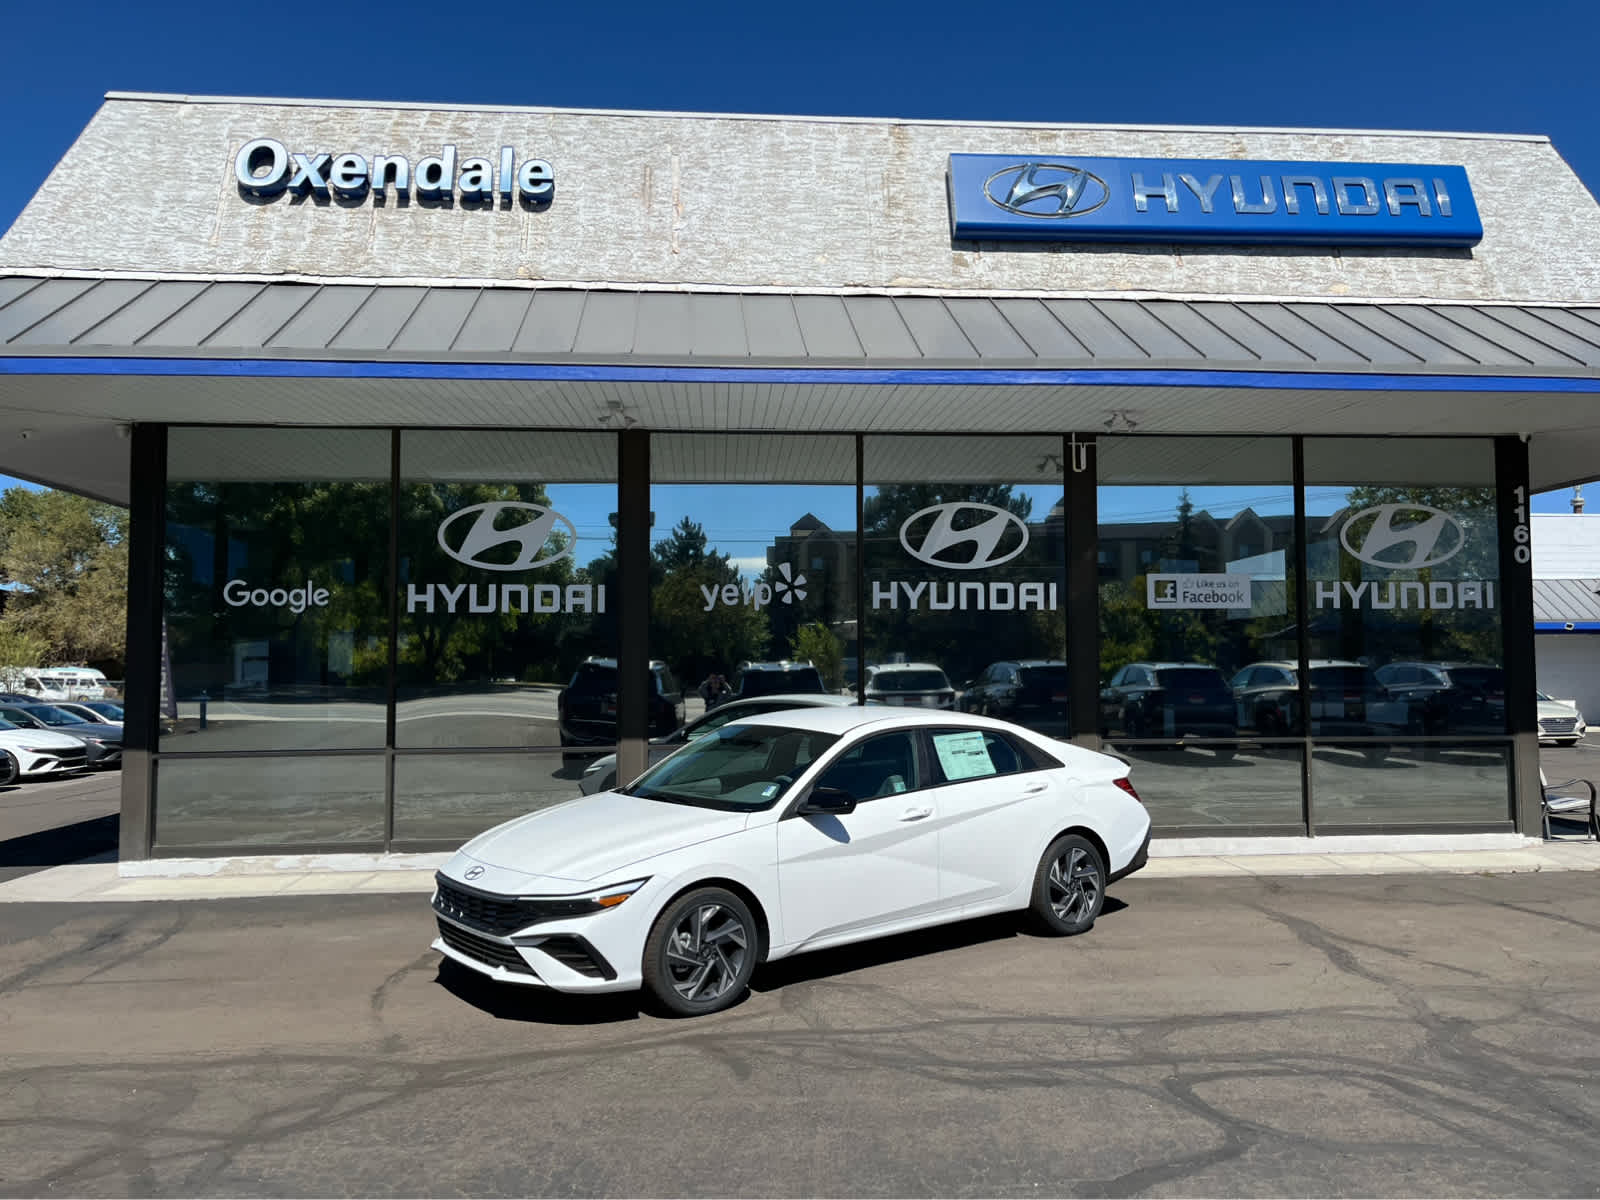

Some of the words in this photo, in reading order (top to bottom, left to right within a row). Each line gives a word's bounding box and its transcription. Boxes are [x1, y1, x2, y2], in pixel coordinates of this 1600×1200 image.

[234, 138, 555, 198] Oxendale
[1131, 172, 1452, 217] HYUNDAI
[1513, 485, 1530, 564] 1160
[223, 579, 330, 614] Google
[407, 583, 606, 614] HYUNDAI
[700, 577, 772, 611] yelp
[872, 581, 1057, 611] HYUNDAI
[1182, 590, 1245, 603] Facebook
[1315, 581, 1494, 609] HYUNDAI
